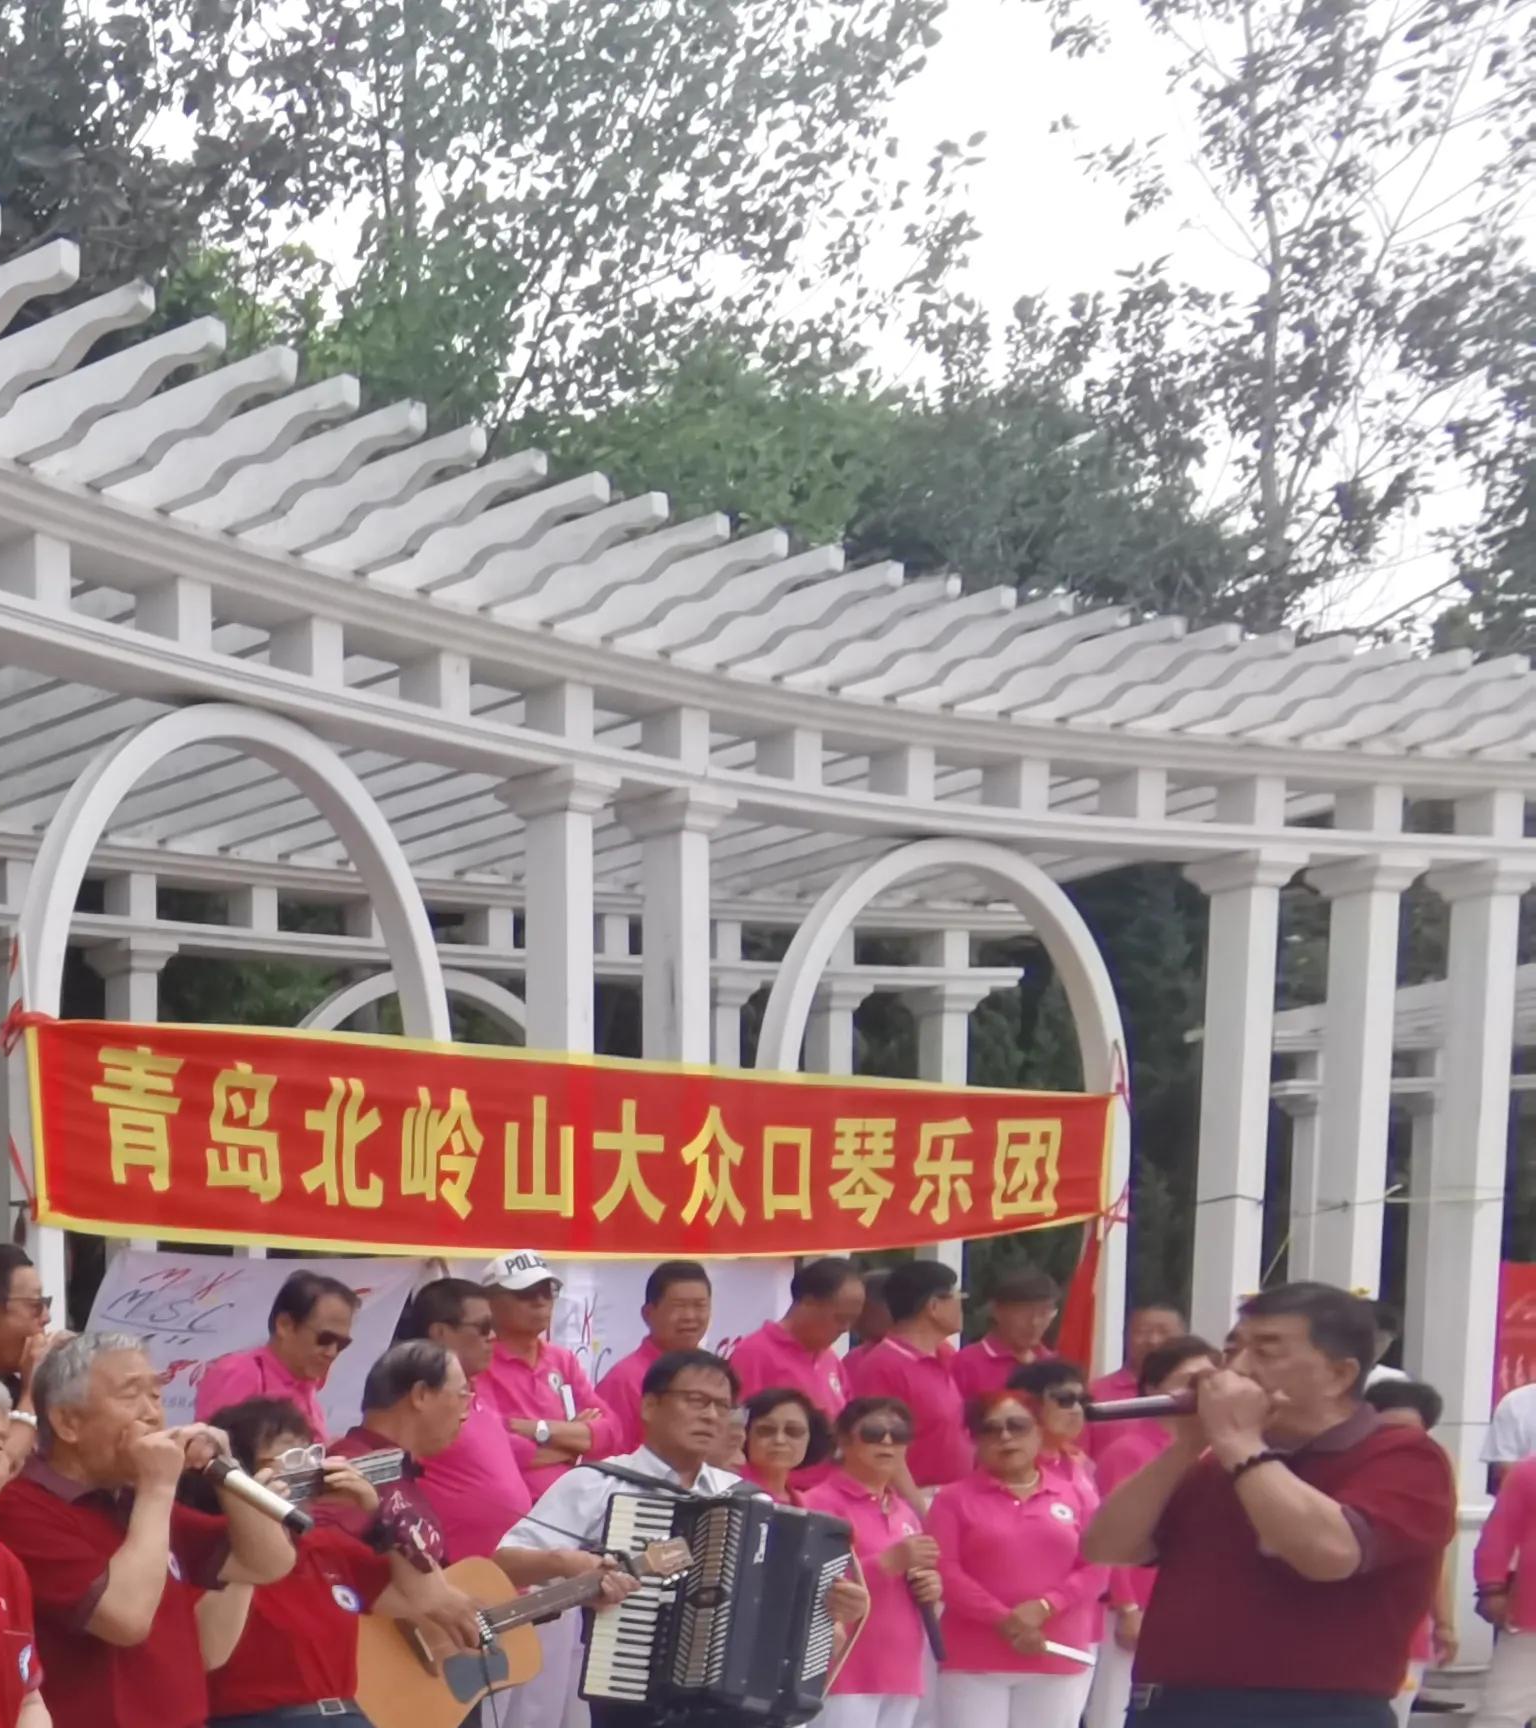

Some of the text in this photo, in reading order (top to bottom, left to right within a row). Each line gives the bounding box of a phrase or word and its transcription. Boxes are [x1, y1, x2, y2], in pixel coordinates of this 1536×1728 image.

[91, 1045, 1064, 1225] 青岛北岭山大众口琴乐团
